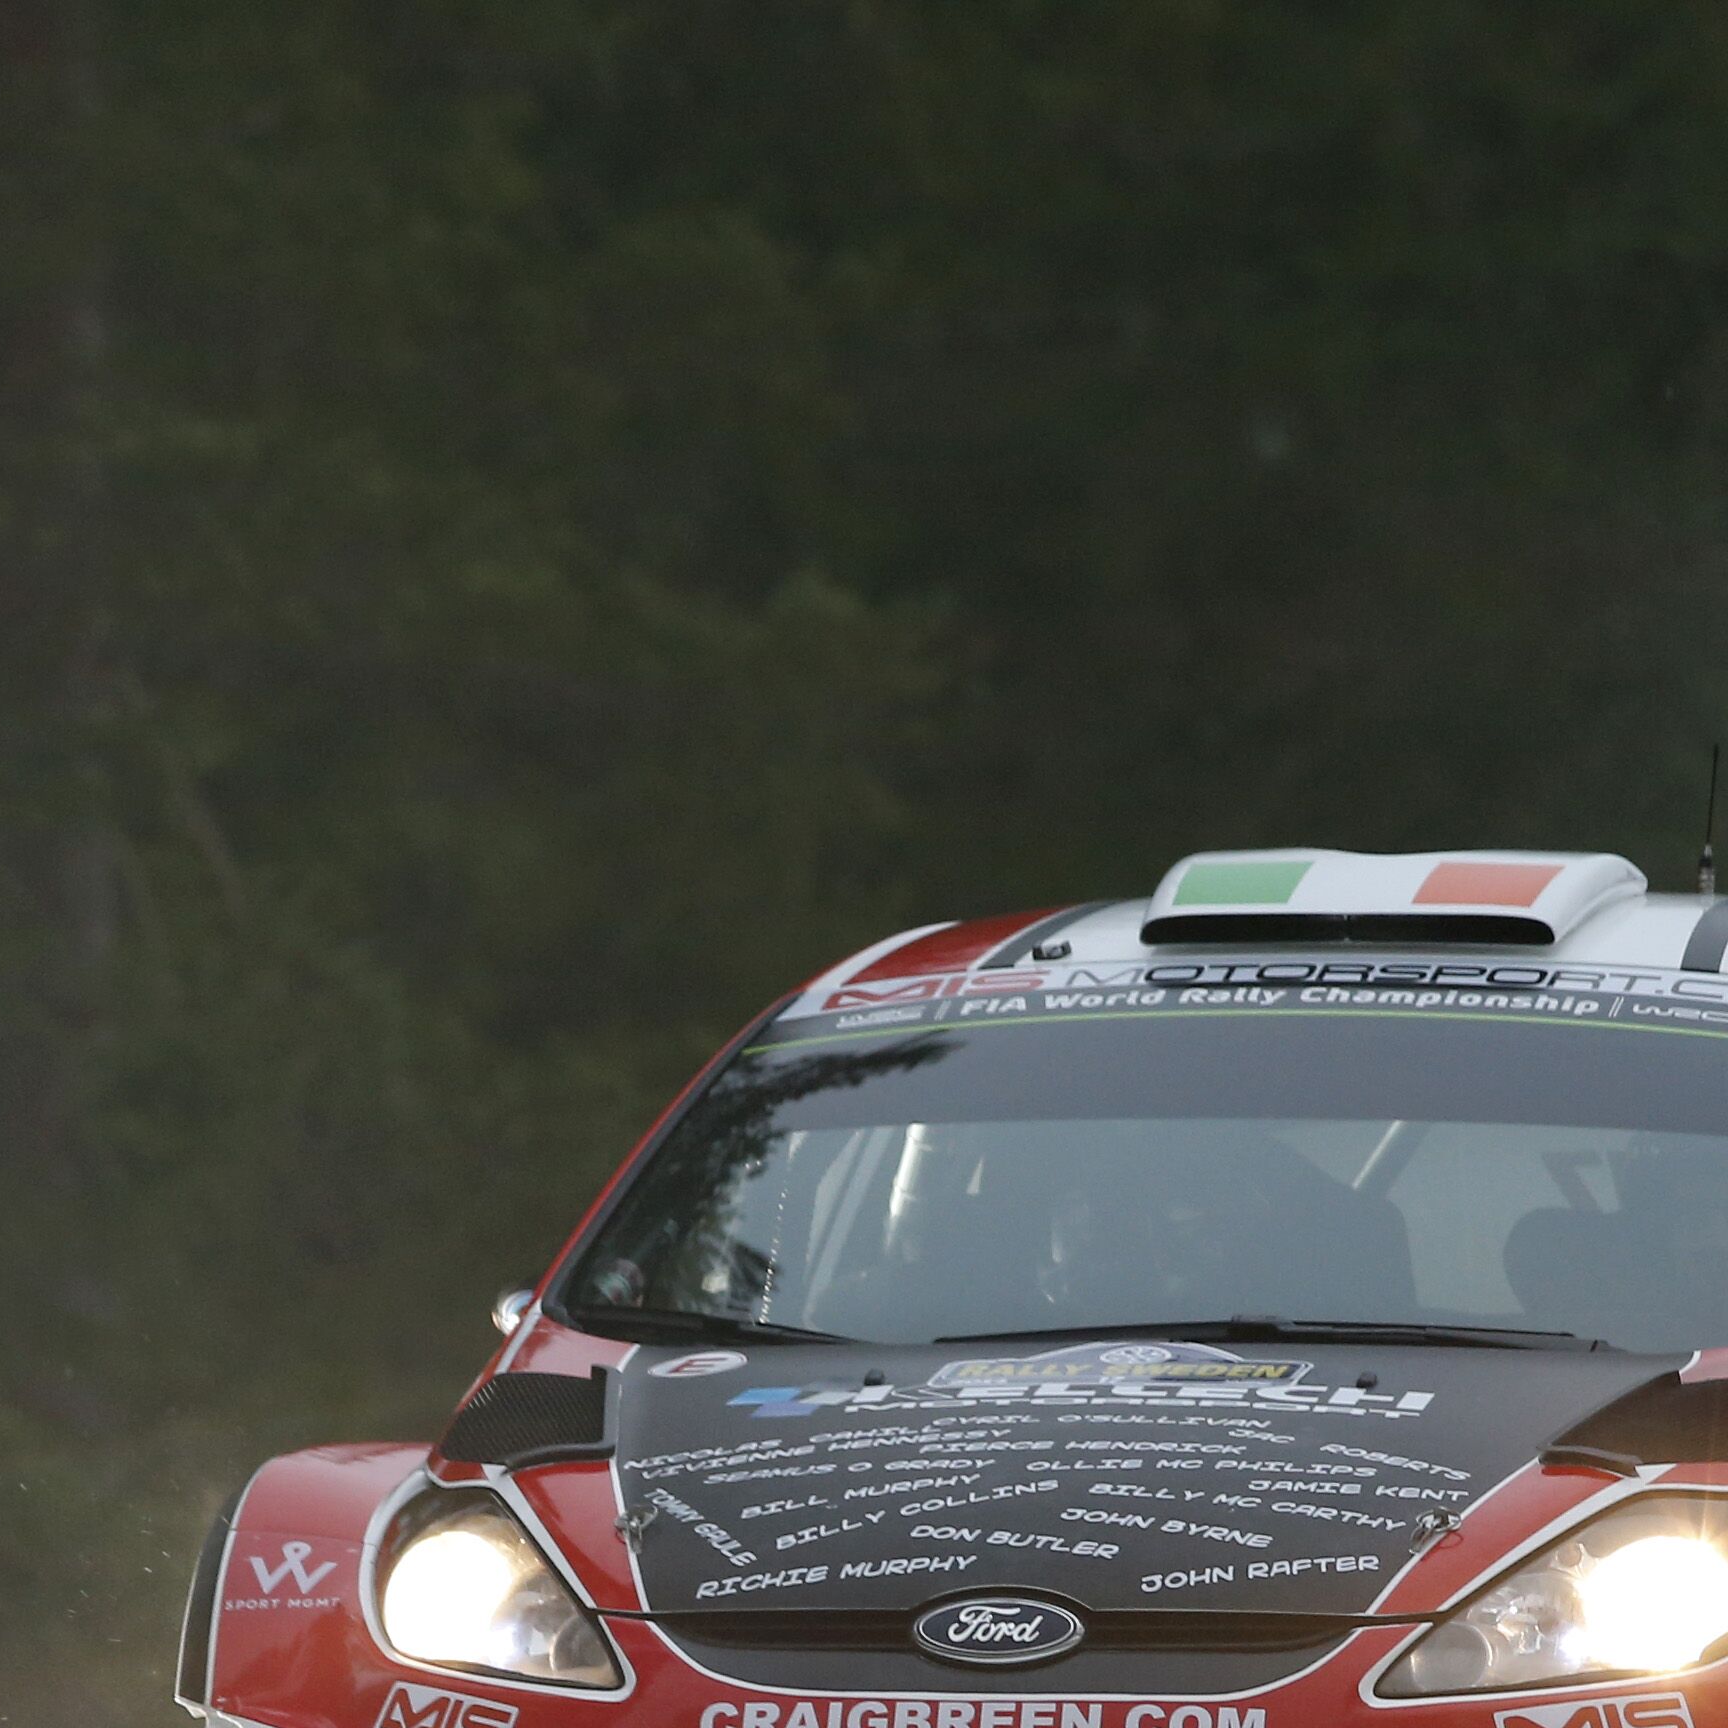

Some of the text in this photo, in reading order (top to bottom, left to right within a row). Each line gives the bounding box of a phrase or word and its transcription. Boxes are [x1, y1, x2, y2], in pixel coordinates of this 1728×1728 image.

[961, 995, 1027, 1016] FIA
[1044, 988, 1166, 1009] World
[1179, 985, 1287, 1006] Rally
[1300, 985, 1599, 1016] Championship
[641, 1428, 1012, 1479] VIVIENNE HENNESSY
[884, 1458, 996, 1472] GRADY
[919, 1440, 1247, 1455] PIERCE HENDRICK
[1320, 1443, 1472, 1481] ROBERTS
[1026, 1458, 1378, 1478] OLLIE MC PHILIPS
[644, 1488, 705, 1524] TOMMY
[740, 1473, 982, 1520] BILL MURPHY
[1088, 1482, 1407, 1533] BILLY MC CARTHY
[1247, 1479, 1470, 1502] JAMIE KENT
[775, 1479, 1060, 1551] BILLY COLLINS
[1060, 1507, 1274, 1549] JOHN BYRNE
[909, 1524, 1121, 1560] DON BUTLER
[695, 1554, 978, 1600] RICHIE MURPHY
[1140, 1553, 1381, 1594] JOHN RAFTER
[223, 1596, 341, 1611] SPORT MGMT
[946, 1604, 1045, 1645] Ford
